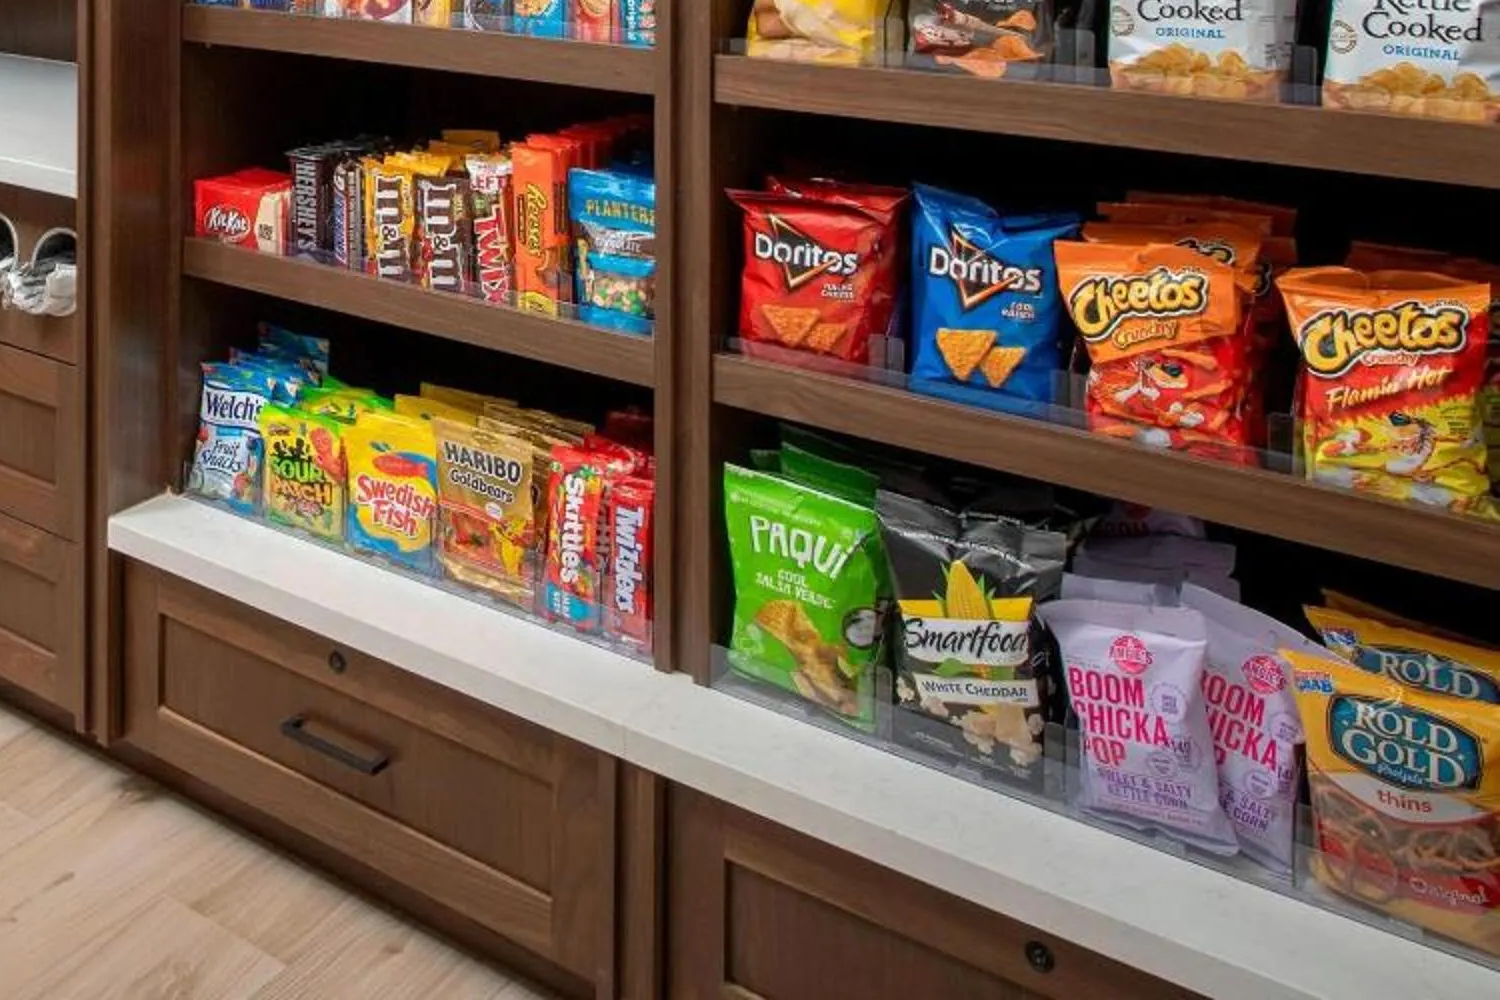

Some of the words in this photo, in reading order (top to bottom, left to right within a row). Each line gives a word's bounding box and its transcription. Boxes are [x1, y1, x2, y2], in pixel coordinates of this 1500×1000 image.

[1155, 26, 1226, 40] ORIGINAL
[1361, 11, 1483, 43] Cooked
[1382, 43, 1461, 62] ORIGINAL
[755, 231, 859, 275] Doritos
[929, 246, 1042, 292] Doritos
[1072, 272, 1204, 338] Cheetos
[1303, 303, 1463, 374] Cheetos
[1405, 365, 1454, 391] Hot
[444, 441, 521, 484] HARIBO
[356, 474, 437, 520] Swedish
[451, 468, 513, 504] Goldbears
[371, 500, 419, 537] Fish
[561, 473, 586, 584] Skittles
[750, 515, 848, 580] PAQUI
[965, 681, 1028, 698] CHEDDAR
[1067, 664, 1145, 709] BOOM
[1380, 651, 1481, 699] ROLD
[1073, 700, 1169, 746] CHICKA
[1355, 701, 1459, 754] ROLD
[1342, 729, 1466, 788] GOLD
[1376, 789, 1433, 814] thins
